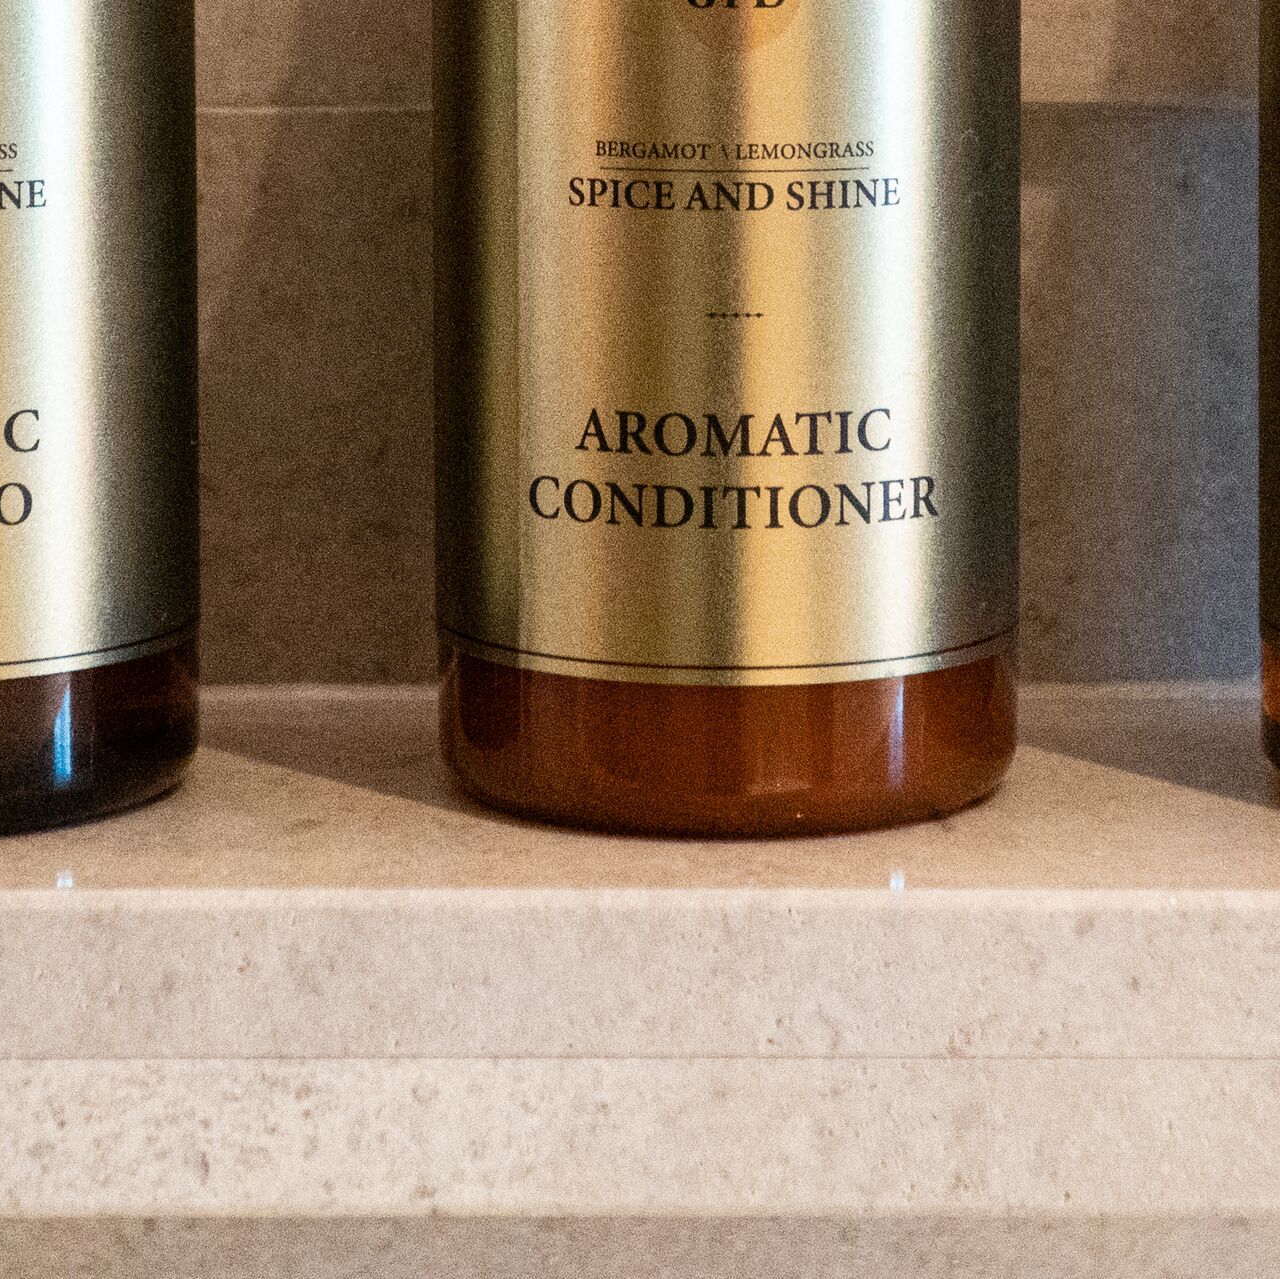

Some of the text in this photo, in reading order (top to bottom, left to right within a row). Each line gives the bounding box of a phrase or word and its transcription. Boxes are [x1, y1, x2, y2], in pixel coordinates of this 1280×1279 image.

[595, 140, 710, 160] BERGAMOT
[735, 139, 875, 161] LEMONGRASS
[568, 177, 901, 211] SPICE AND SHINE
[575, 407, 892, 458] AROMATIC
[529, 475, 939, 531] CONDITIONER
